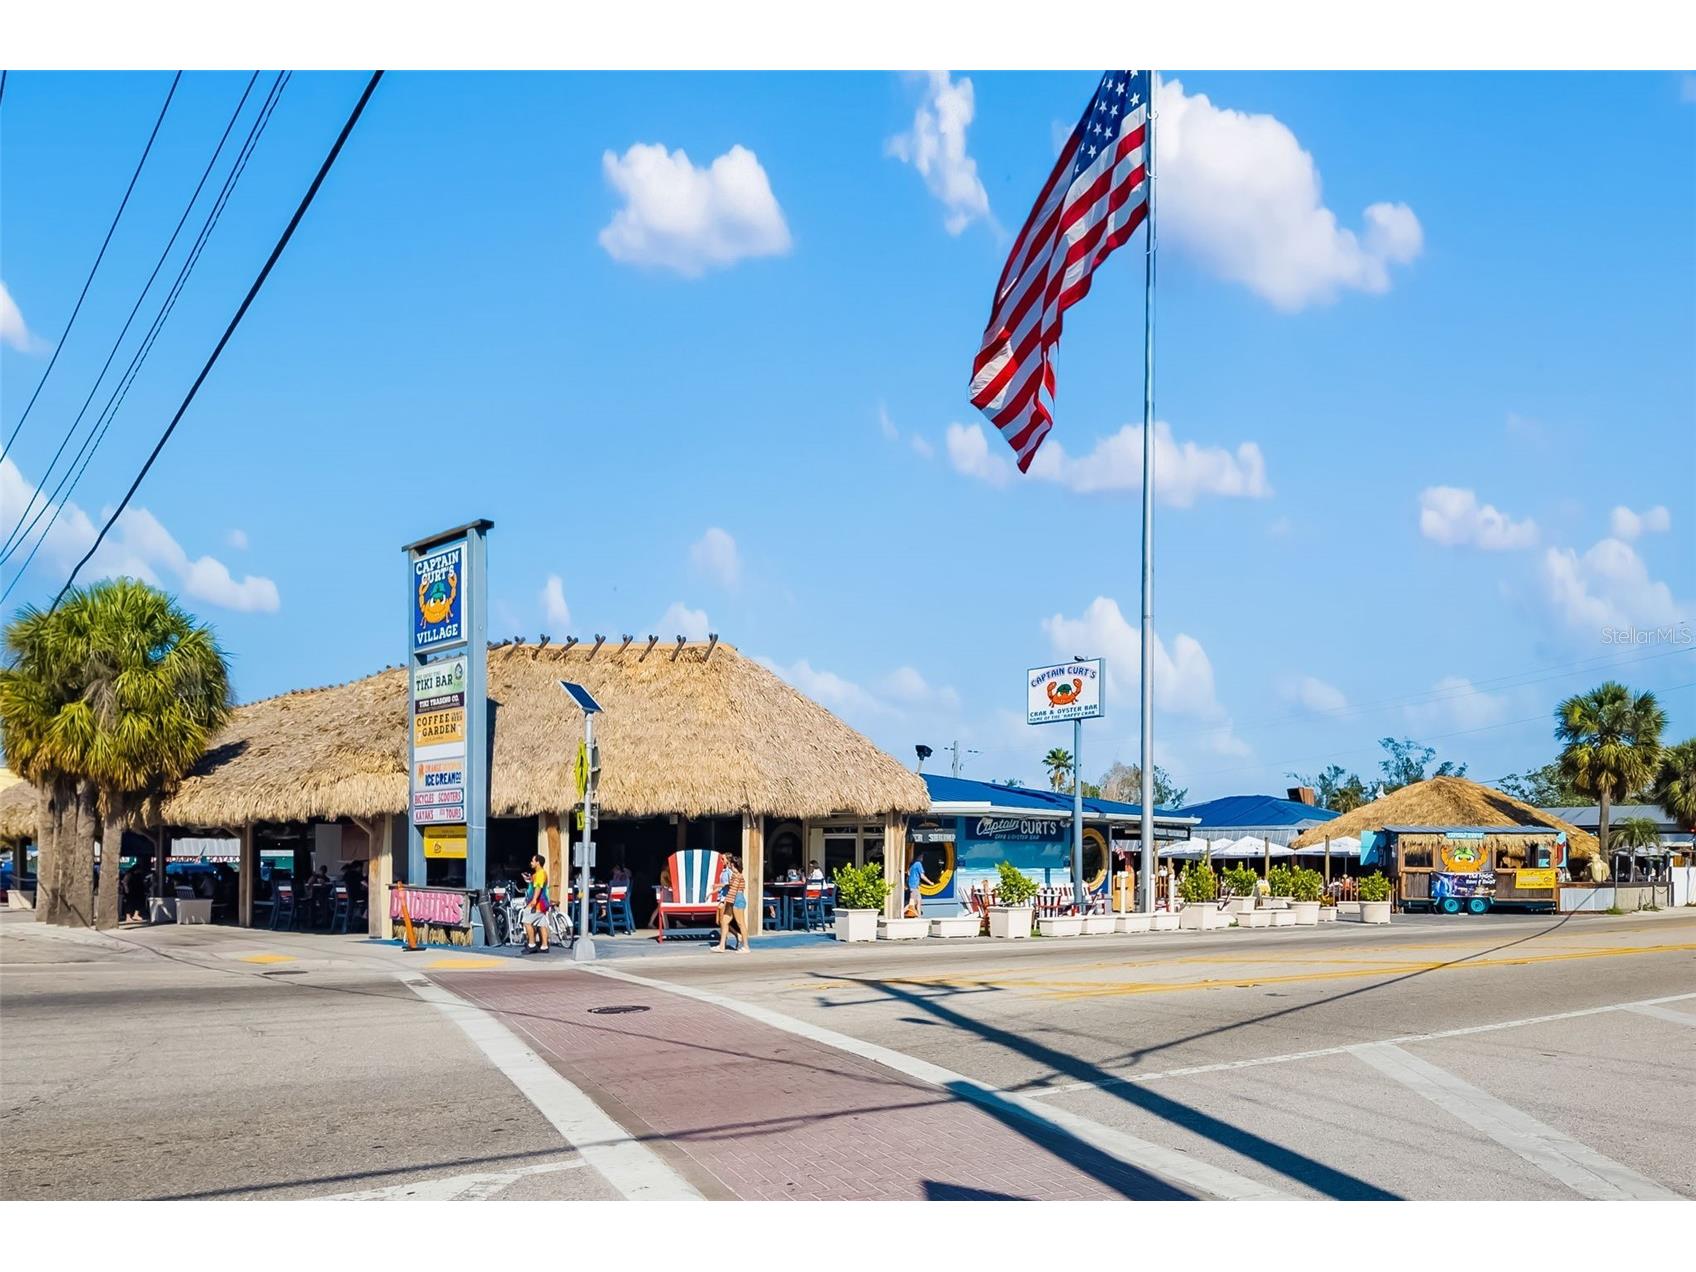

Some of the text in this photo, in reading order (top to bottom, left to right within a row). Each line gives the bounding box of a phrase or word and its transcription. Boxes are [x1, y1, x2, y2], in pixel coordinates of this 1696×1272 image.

[416, 550, 459, 575] CAPTAIN
[421, 565, 455, 584] CURT'S
[417, 623, 458, 645] VILLAGE
[416, 678, 433, 691] TIKI
[436, 674, 453, 688] BAR
[1031, 666, 1097, 687] CAPTAIN CURT'S
[419, 700, 430, 708] TIKI
[430, 696, 451, 707] TRADING
[1057, 706, 1082, 714] OYSTER
[416, 713, 450, 727] COFFEE
[422, 723, 456, 737] GARDEN
[425, 774, 435, 786] ICE
[435, 772, 456, 785] CREAM
[415, 791, 461, 804] BICYCLES SCOOTERS
[416, 810, 434, 820] KAYAKS
[446, 808, 461, 819] TOURS
[976, 817, 1057, 836] Captain CURT'S
